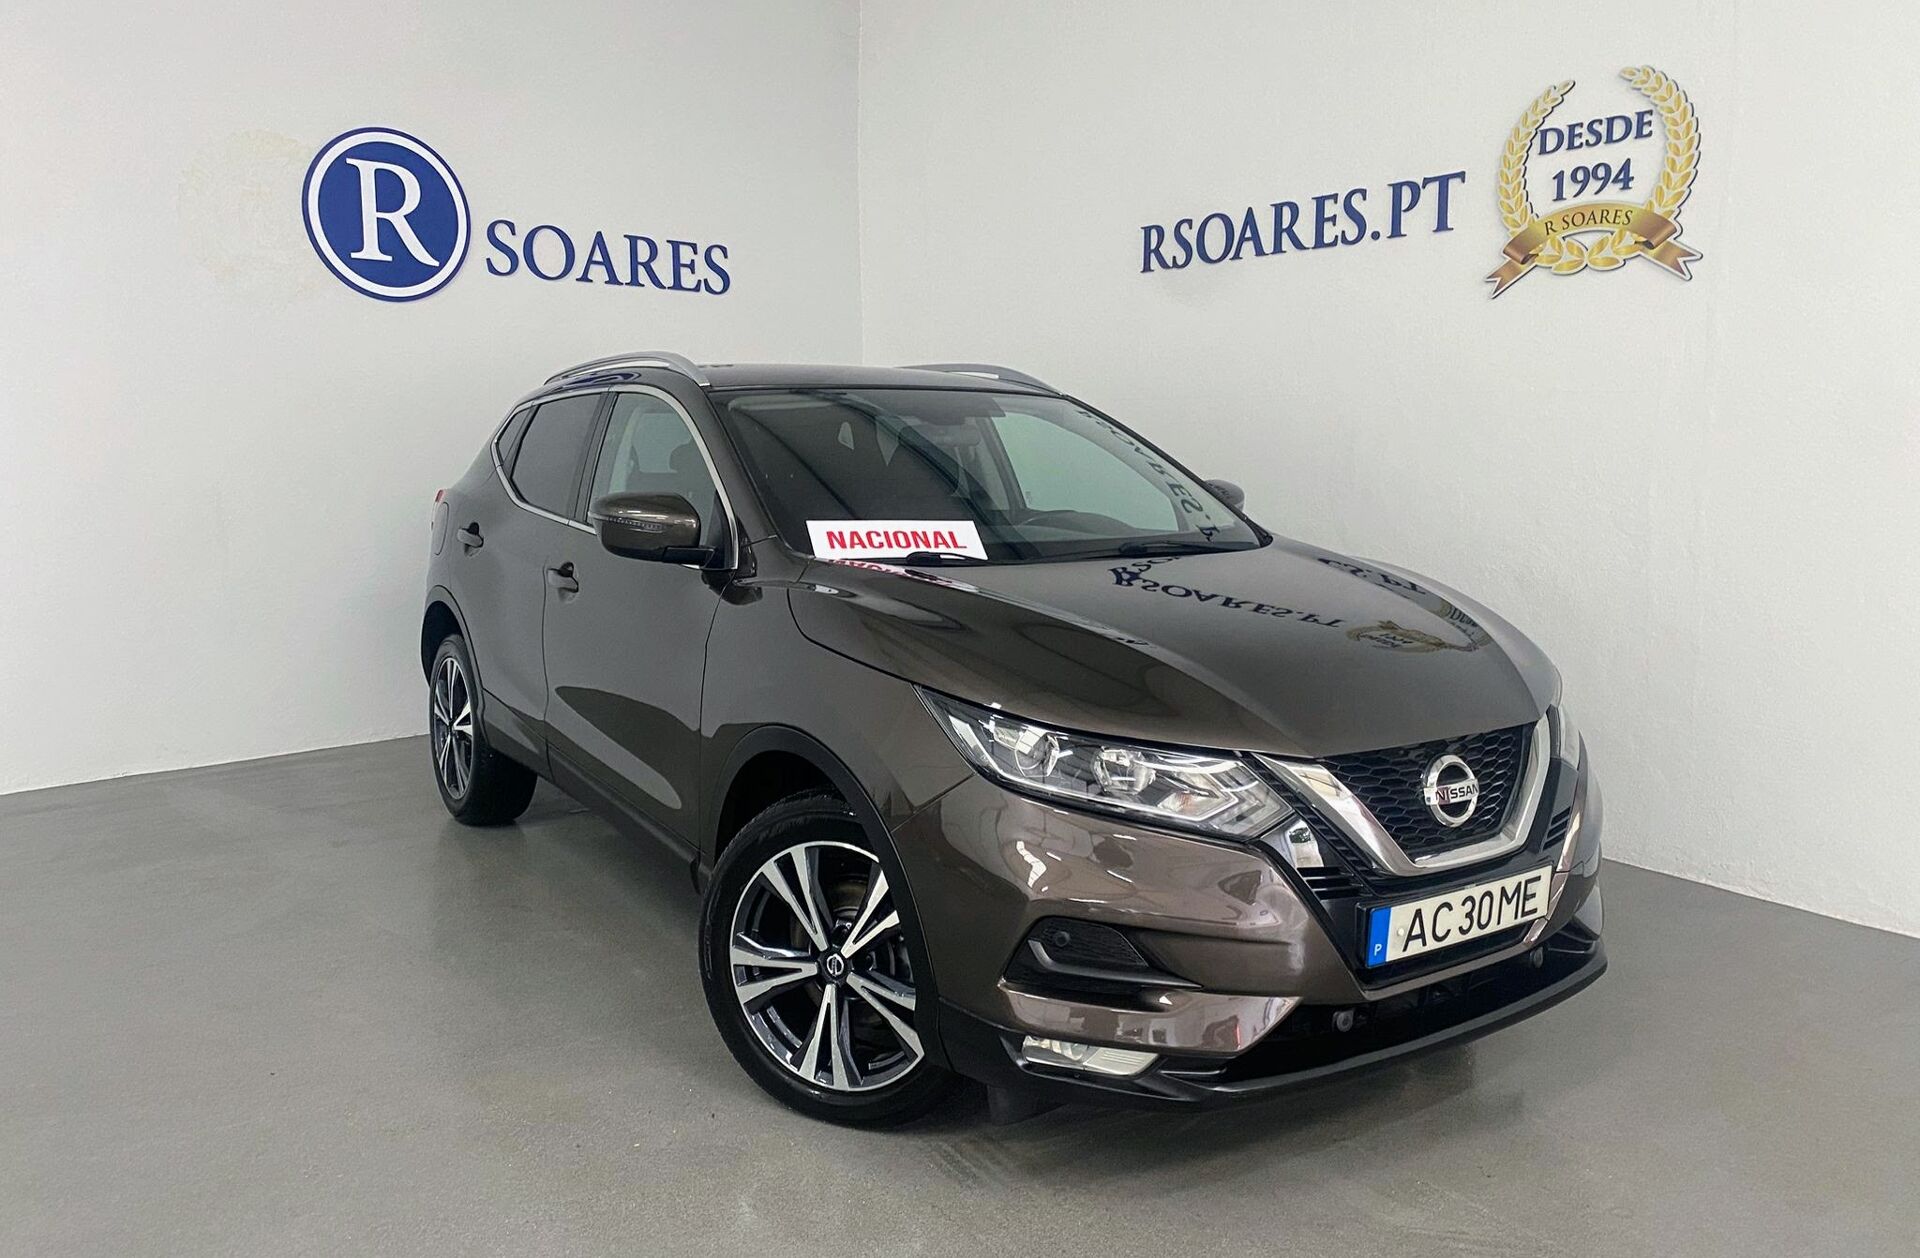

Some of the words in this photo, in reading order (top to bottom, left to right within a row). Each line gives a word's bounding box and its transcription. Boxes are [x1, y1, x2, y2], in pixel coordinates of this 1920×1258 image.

[1537, 109, 1654, 156] DESDE
[1551, 158, 1636, 202] 1994
[345, 157, 440, 268] R
[485, 219, 732, 295] SOARES
[1140, 171, 1467, 273] RSOARES.PT
[1544, 220, 1558, 236] R
[1562, 208, 1634, 231] SOARES
[825, 530, 968, 550] NACIONAL
[1435, 783, 1479, 801] NISSAN
[1373, 943, 1383, 957] P
